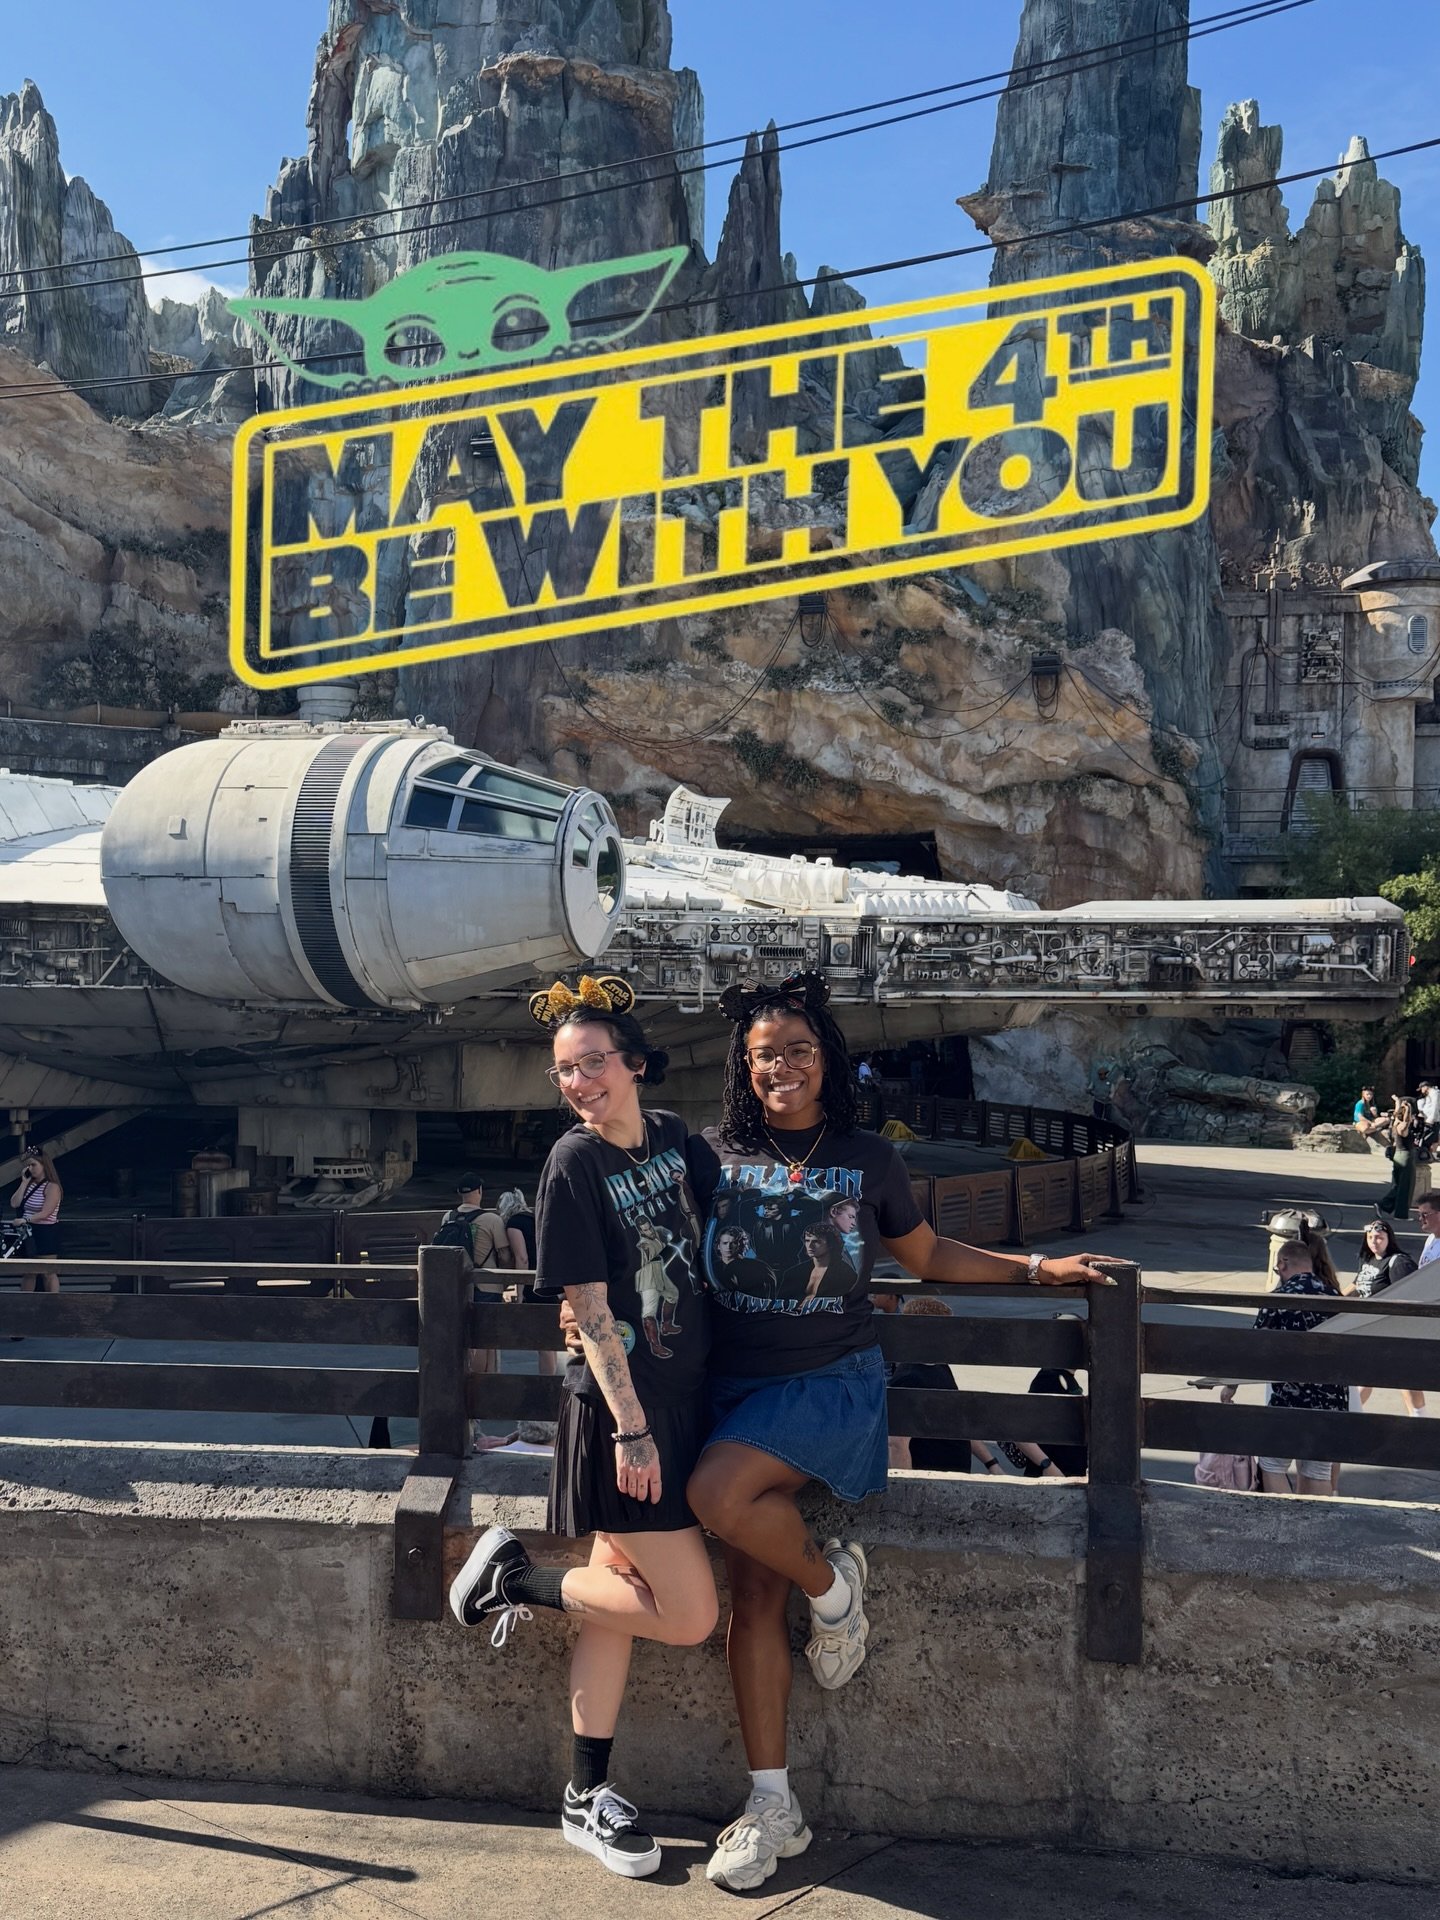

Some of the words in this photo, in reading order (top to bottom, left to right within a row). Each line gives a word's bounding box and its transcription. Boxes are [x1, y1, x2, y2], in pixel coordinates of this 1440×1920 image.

[604, 982, 630, 1001] STAR
[532, 996, 547, 1020] STAR
[540, 1002, 554, 1023] WAR
